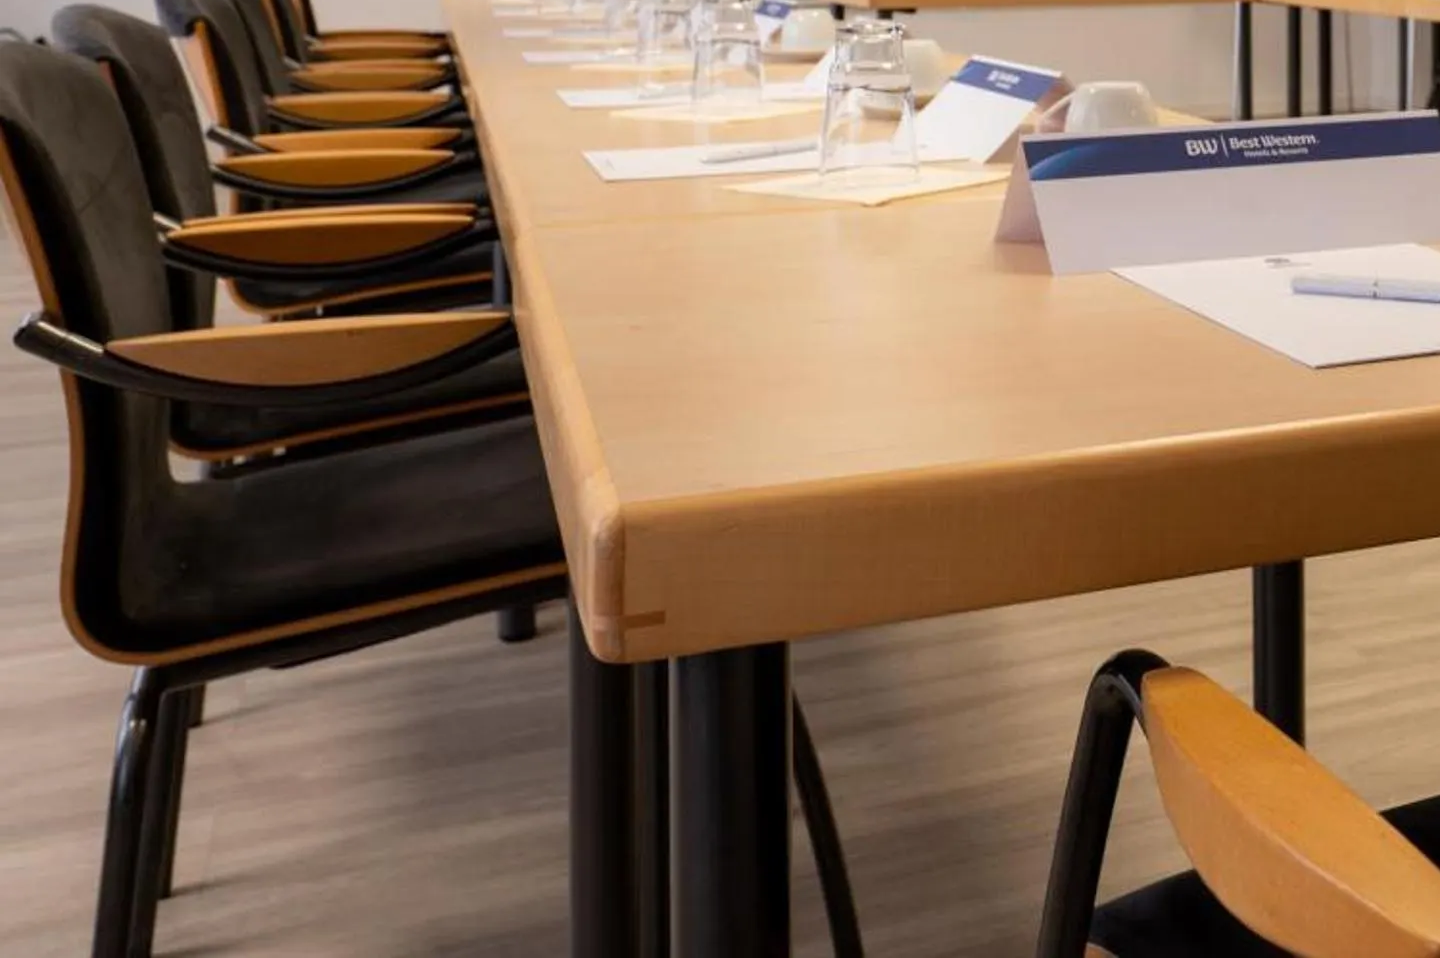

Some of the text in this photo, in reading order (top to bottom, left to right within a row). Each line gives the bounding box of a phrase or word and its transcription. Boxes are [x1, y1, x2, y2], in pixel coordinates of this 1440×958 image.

[1185, 134, 1316, 156] BW Best Western
